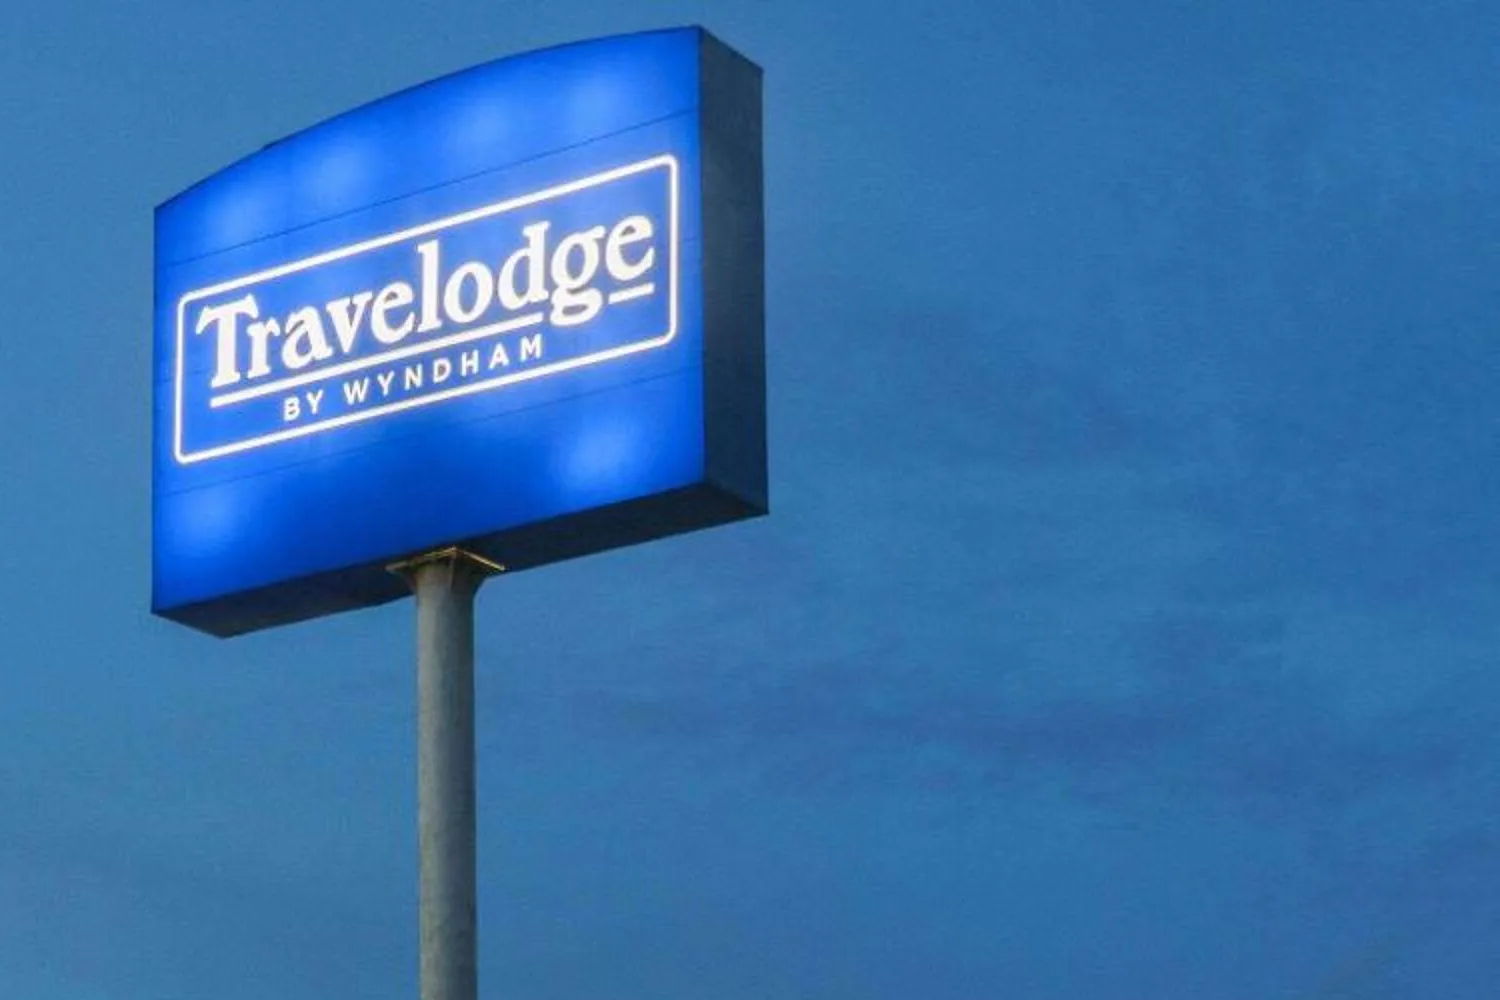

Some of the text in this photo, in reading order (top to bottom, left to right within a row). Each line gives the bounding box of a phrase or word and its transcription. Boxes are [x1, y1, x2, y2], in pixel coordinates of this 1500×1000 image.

[195, 214, 655, 389] Travelodge
[283, 333, 543, 421] BY WYNDHAM
